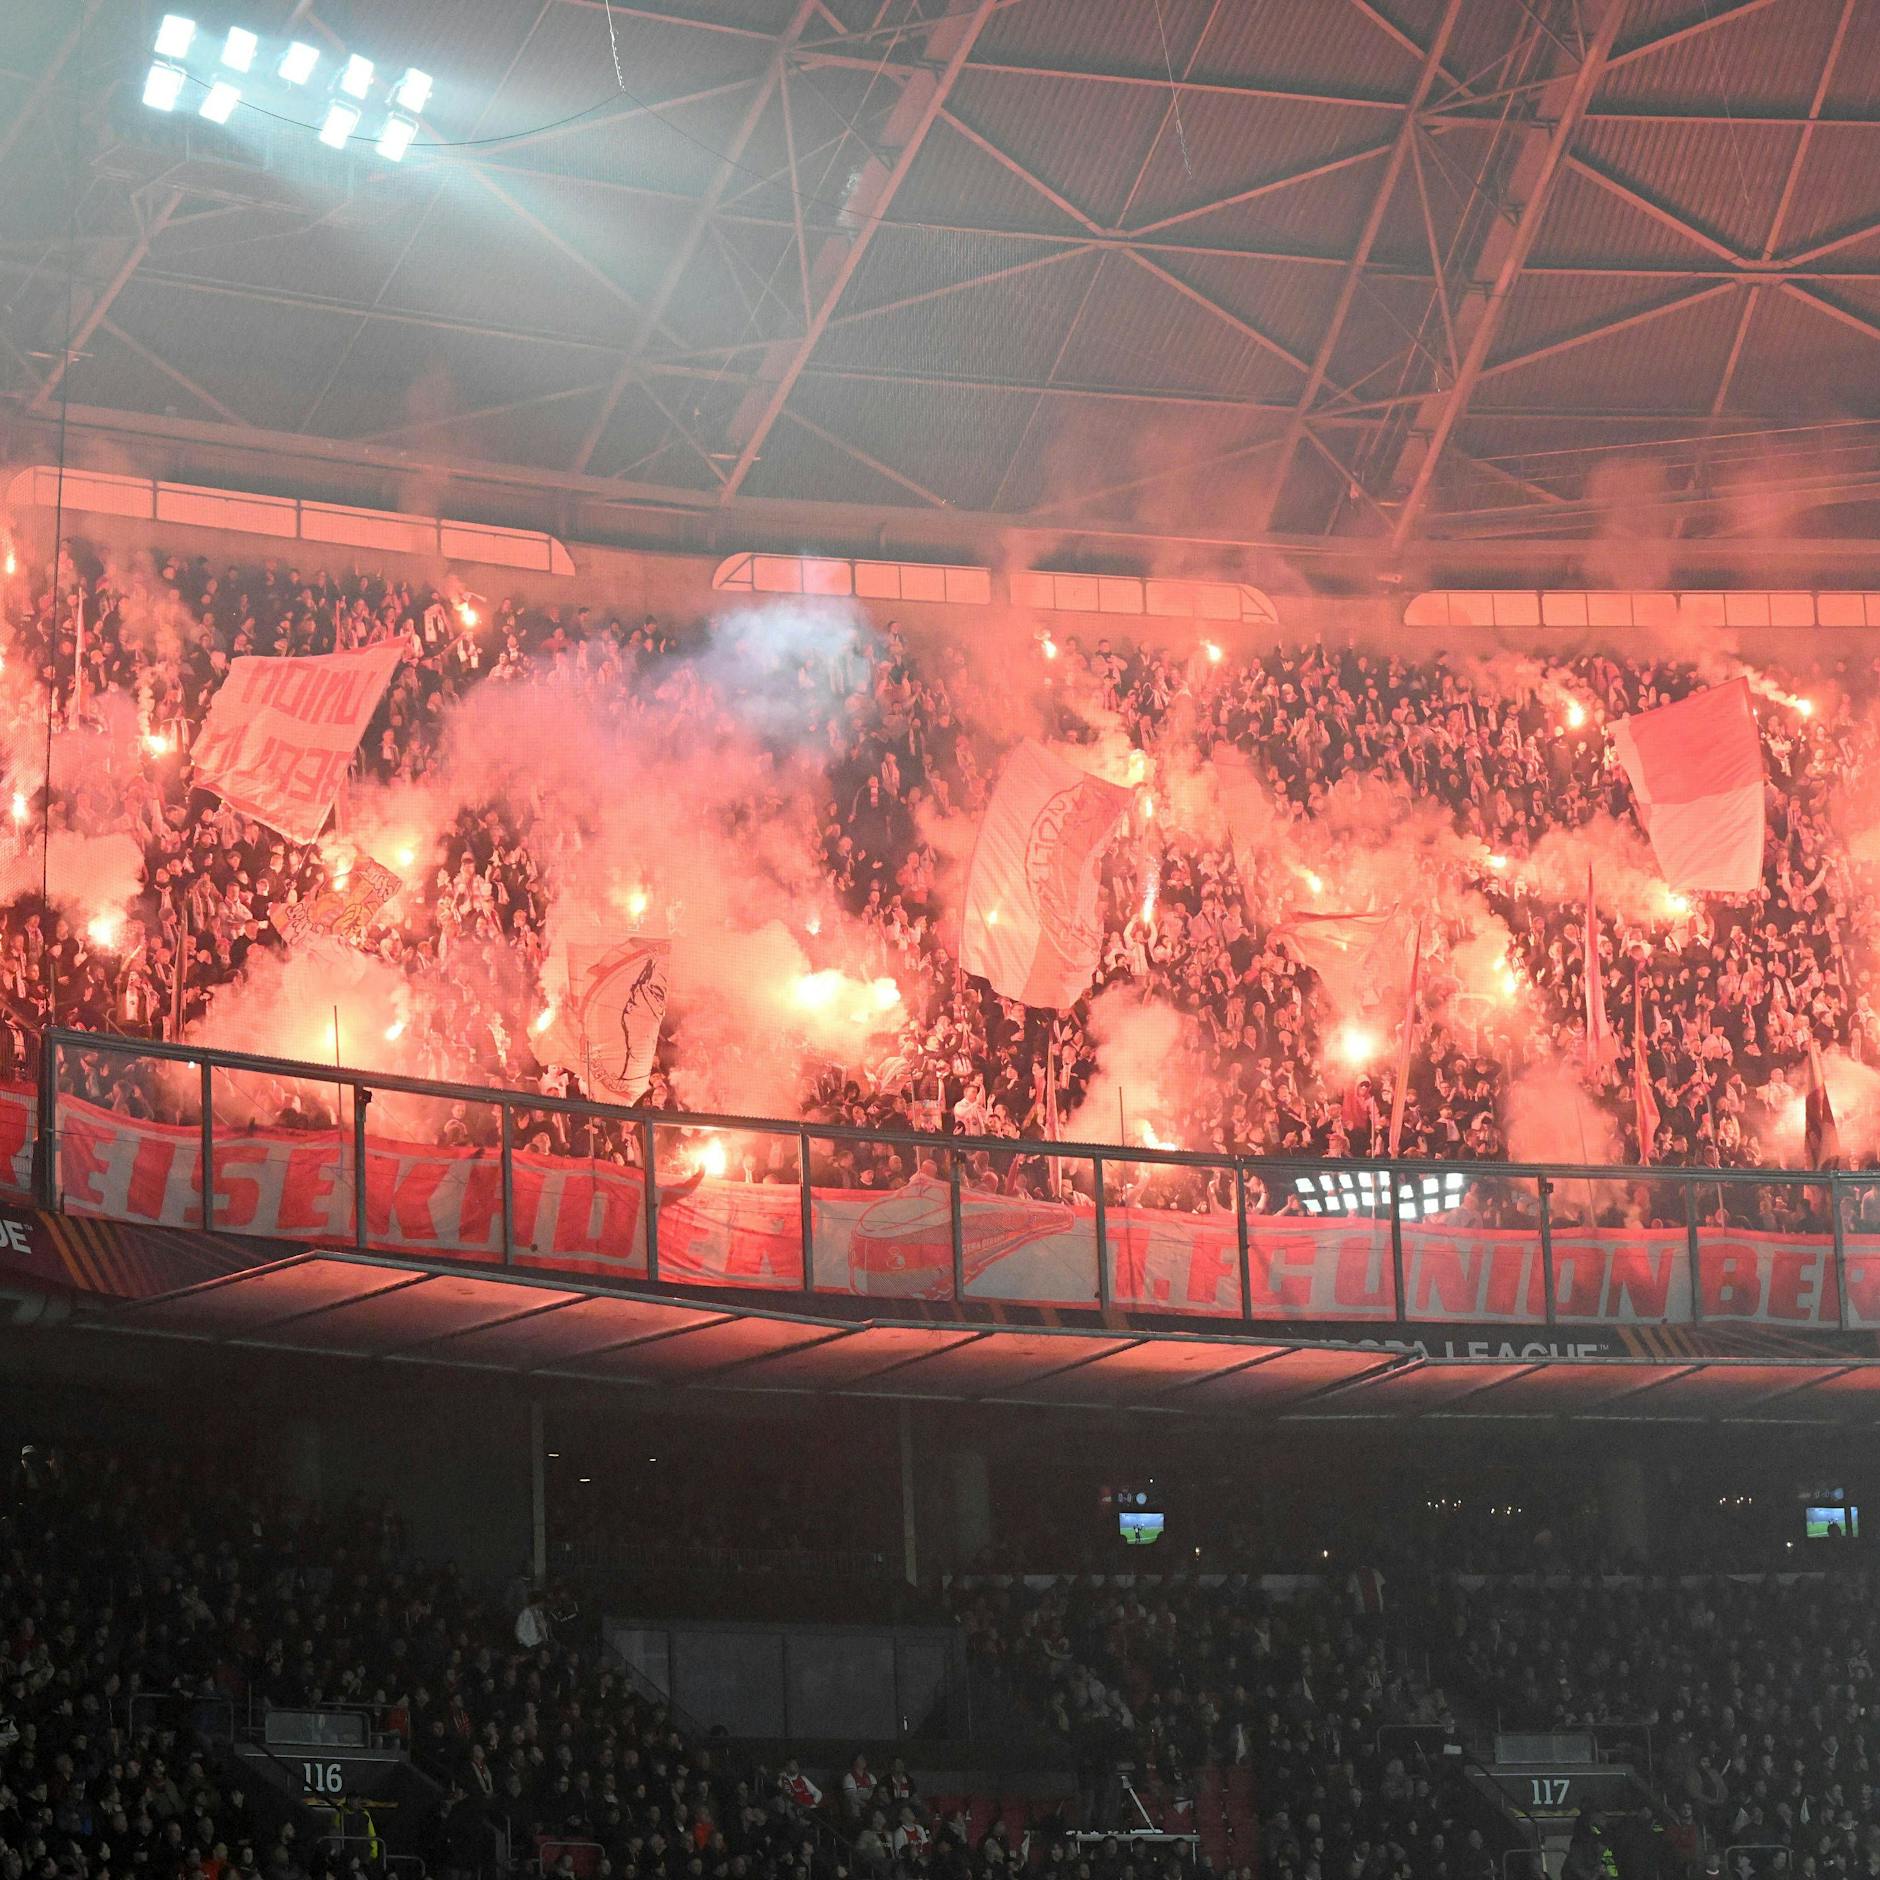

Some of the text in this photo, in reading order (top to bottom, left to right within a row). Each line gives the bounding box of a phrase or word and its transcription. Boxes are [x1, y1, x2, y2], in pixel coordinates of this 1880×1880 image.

[1333, 1236, 1675, 1318] UNION
[303, 1762, 343, 1793] 116
[1531, 1779, 1570, 1805] 117
